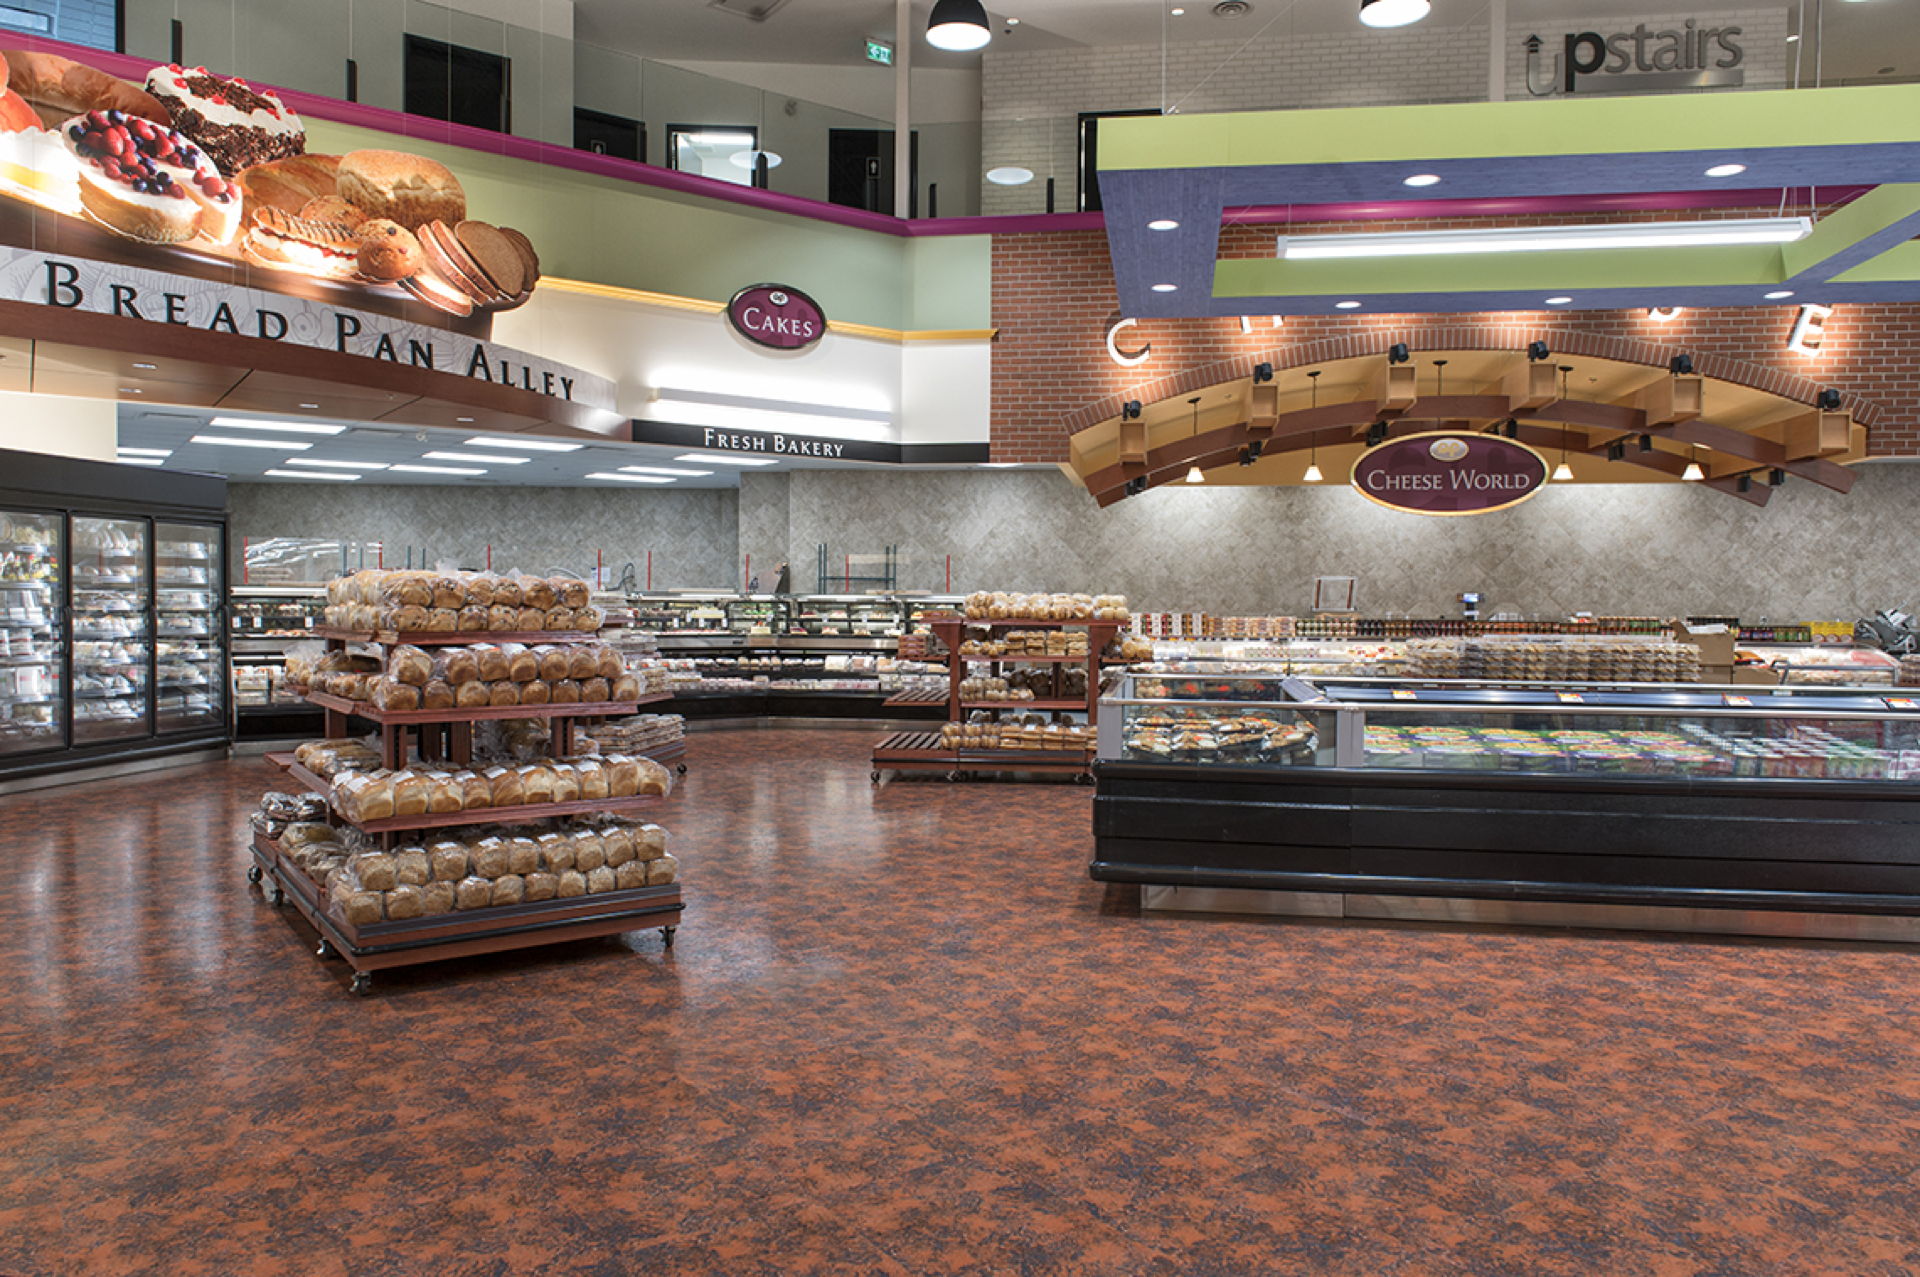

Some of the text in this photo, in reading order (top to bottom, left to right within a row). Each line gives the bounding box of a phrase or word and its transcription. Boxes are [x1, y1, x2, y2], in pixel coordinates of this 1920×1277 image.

[1527, 18, 1744, 97] upstairs
[44, 260, 574, 401] BREAD PAN ALLEY
[743, 307, 813, 338] CAKES
[703, 428, 844, 458] FRESH BAKERY
[1367, 469, 1531, 491] CHEESE WORLD
